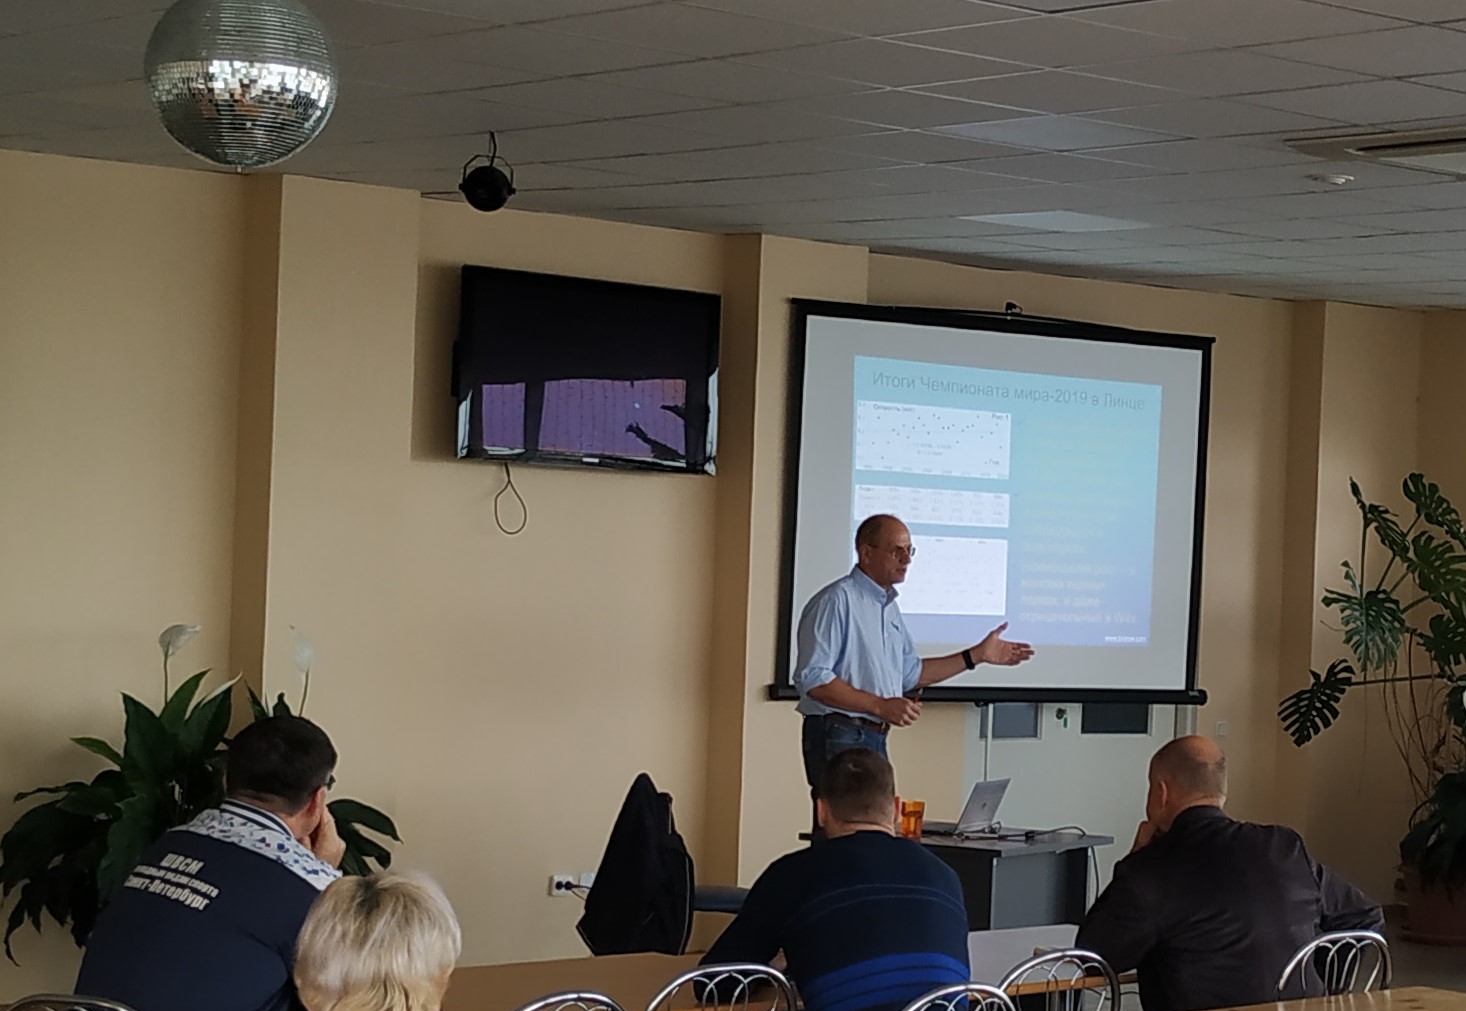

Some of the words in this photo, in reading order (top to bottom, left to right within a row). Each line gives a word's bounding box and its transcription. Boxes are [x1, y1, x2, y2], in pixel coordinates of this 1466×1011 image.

[872, 371, 916, 390] Итоги
[920, 375, 1009, 398] Чемпионата
[1014, 388, 1088, 405] мира-2019
[1092, 395, 1099, 406] в
[1104, 393, 1145, 411] Линце
[160, 852, 204, 875] ШВСМ
